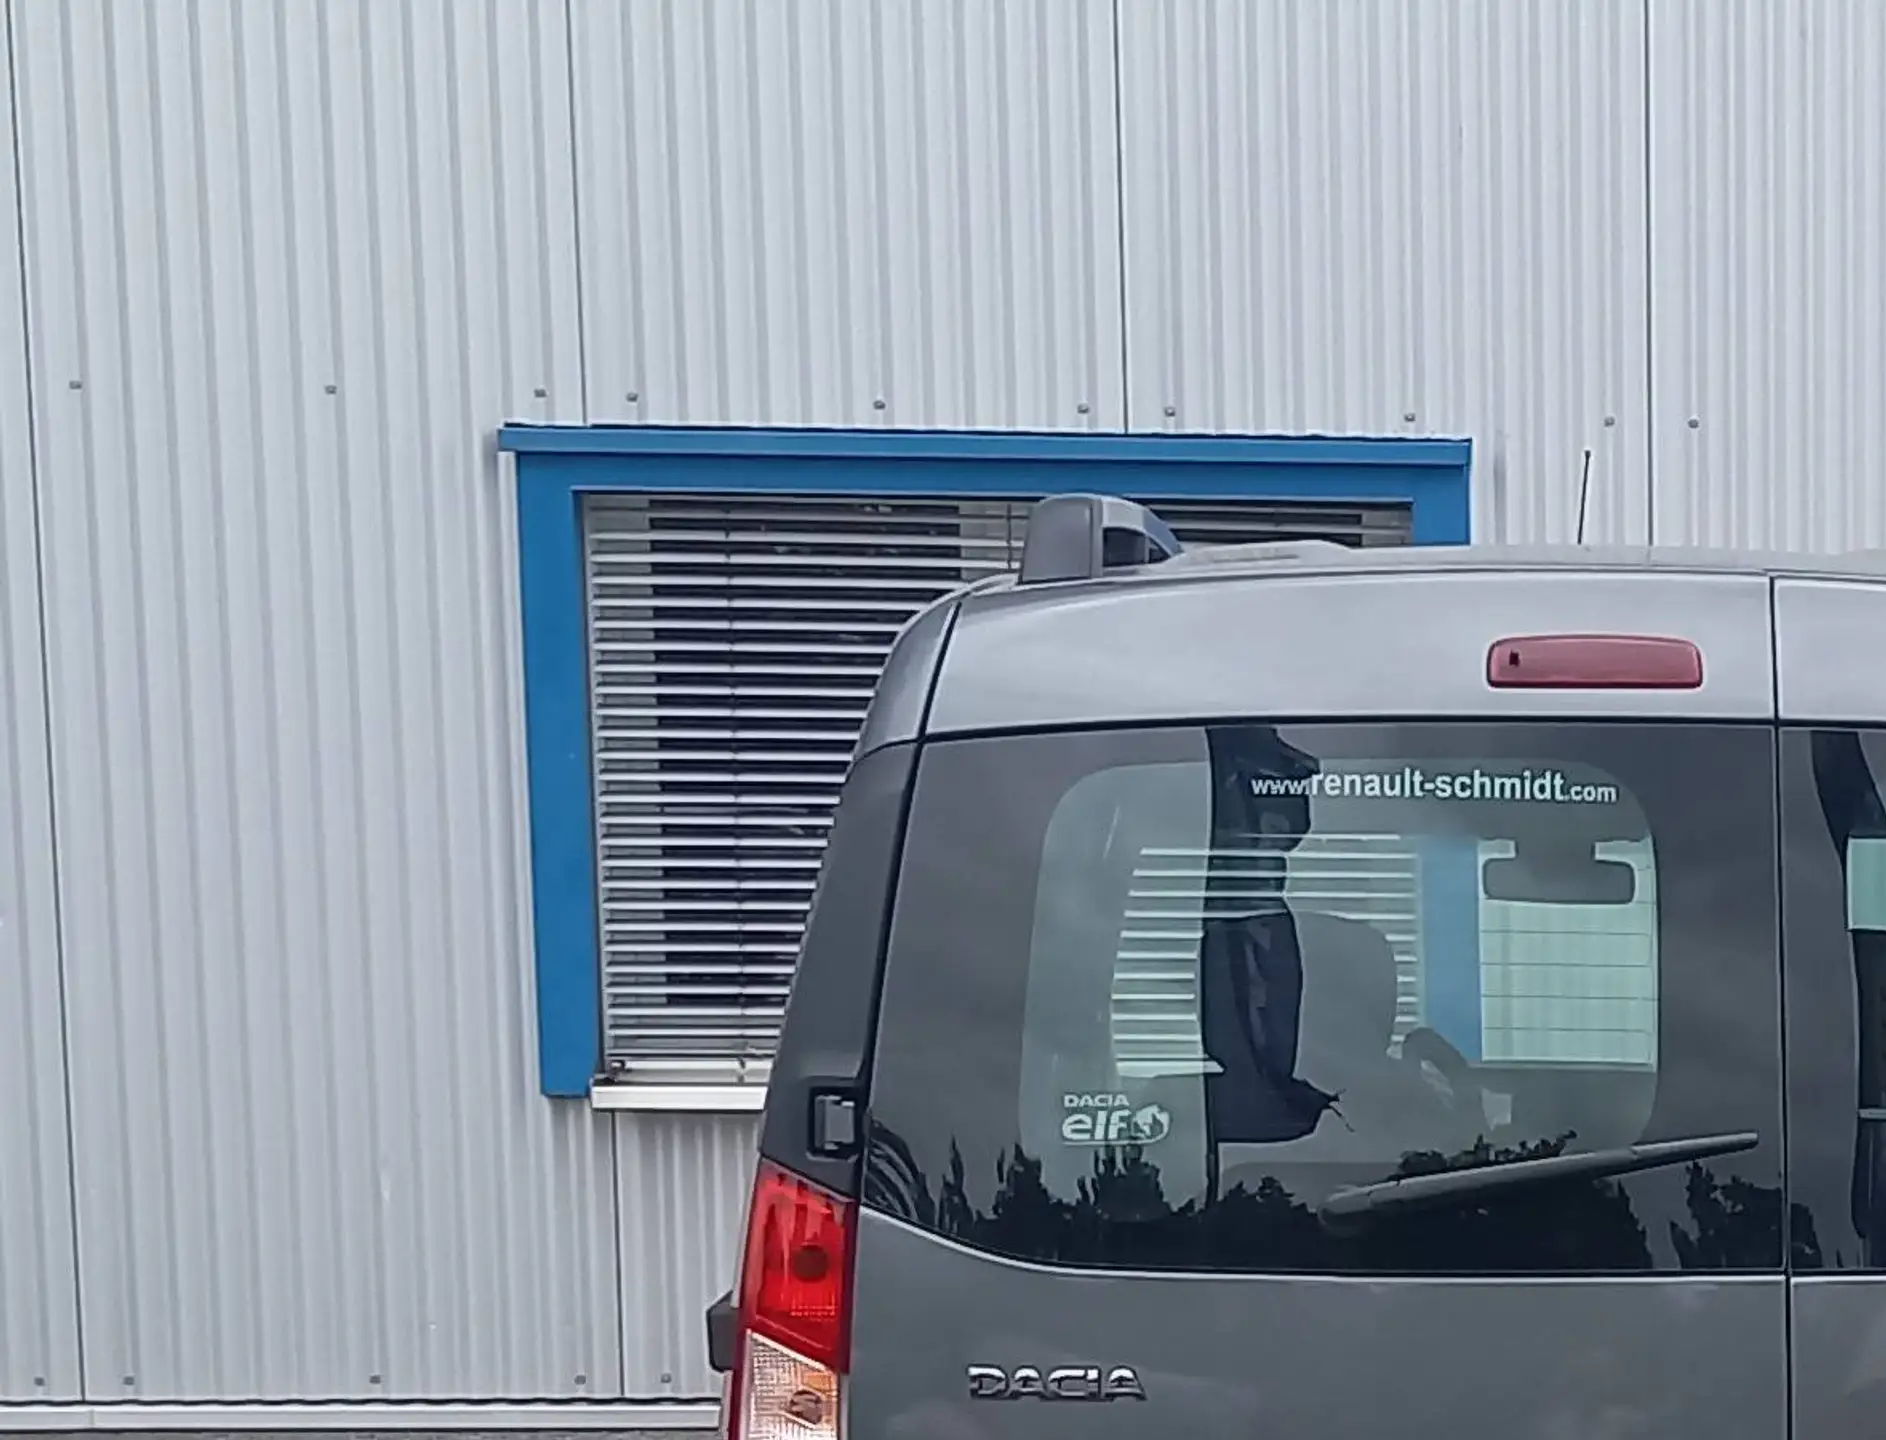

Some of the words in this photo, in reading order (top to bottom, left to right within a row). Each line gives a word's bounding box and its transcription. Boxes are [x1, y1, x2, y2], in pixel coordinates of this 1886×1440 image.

[1251, 766, 1618, 802] www.renault-schmidt.com
[1063, 1094, 1130, 1108] DACIA
[1062, 1108, 1132, 1140] elf
[966, 1363, 1148, 1401] DACIA
